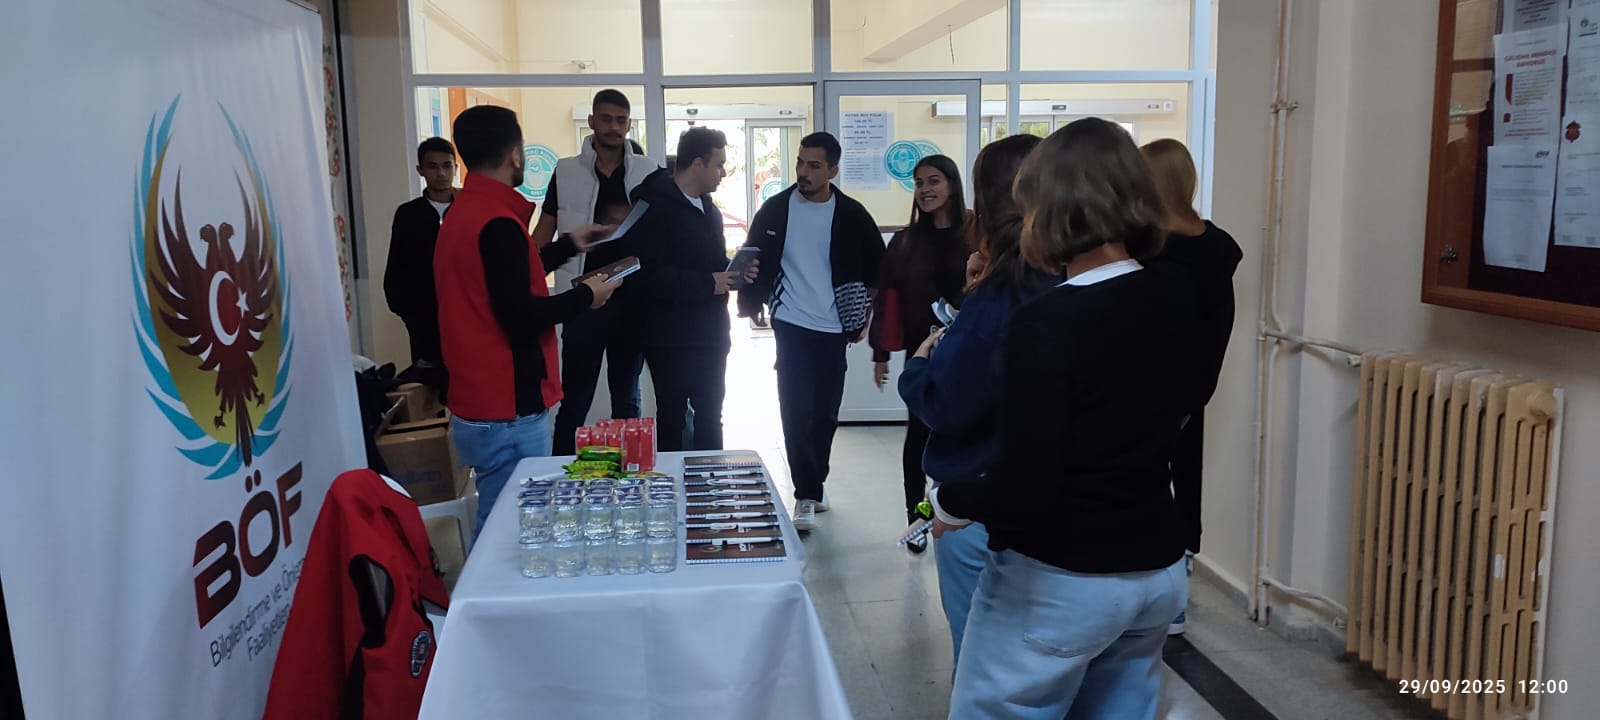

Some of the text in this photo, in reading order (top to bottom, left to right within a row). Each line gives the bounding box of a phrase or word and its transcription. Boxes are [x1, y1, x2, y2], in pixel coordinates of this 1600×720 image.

[193, 461, 303, 630] BÖF
[210, 594, 271, 668] Bilgilendirme
[272, 583, 282, 603] ve
[247, 603, 290, 662] Faaliyetler
